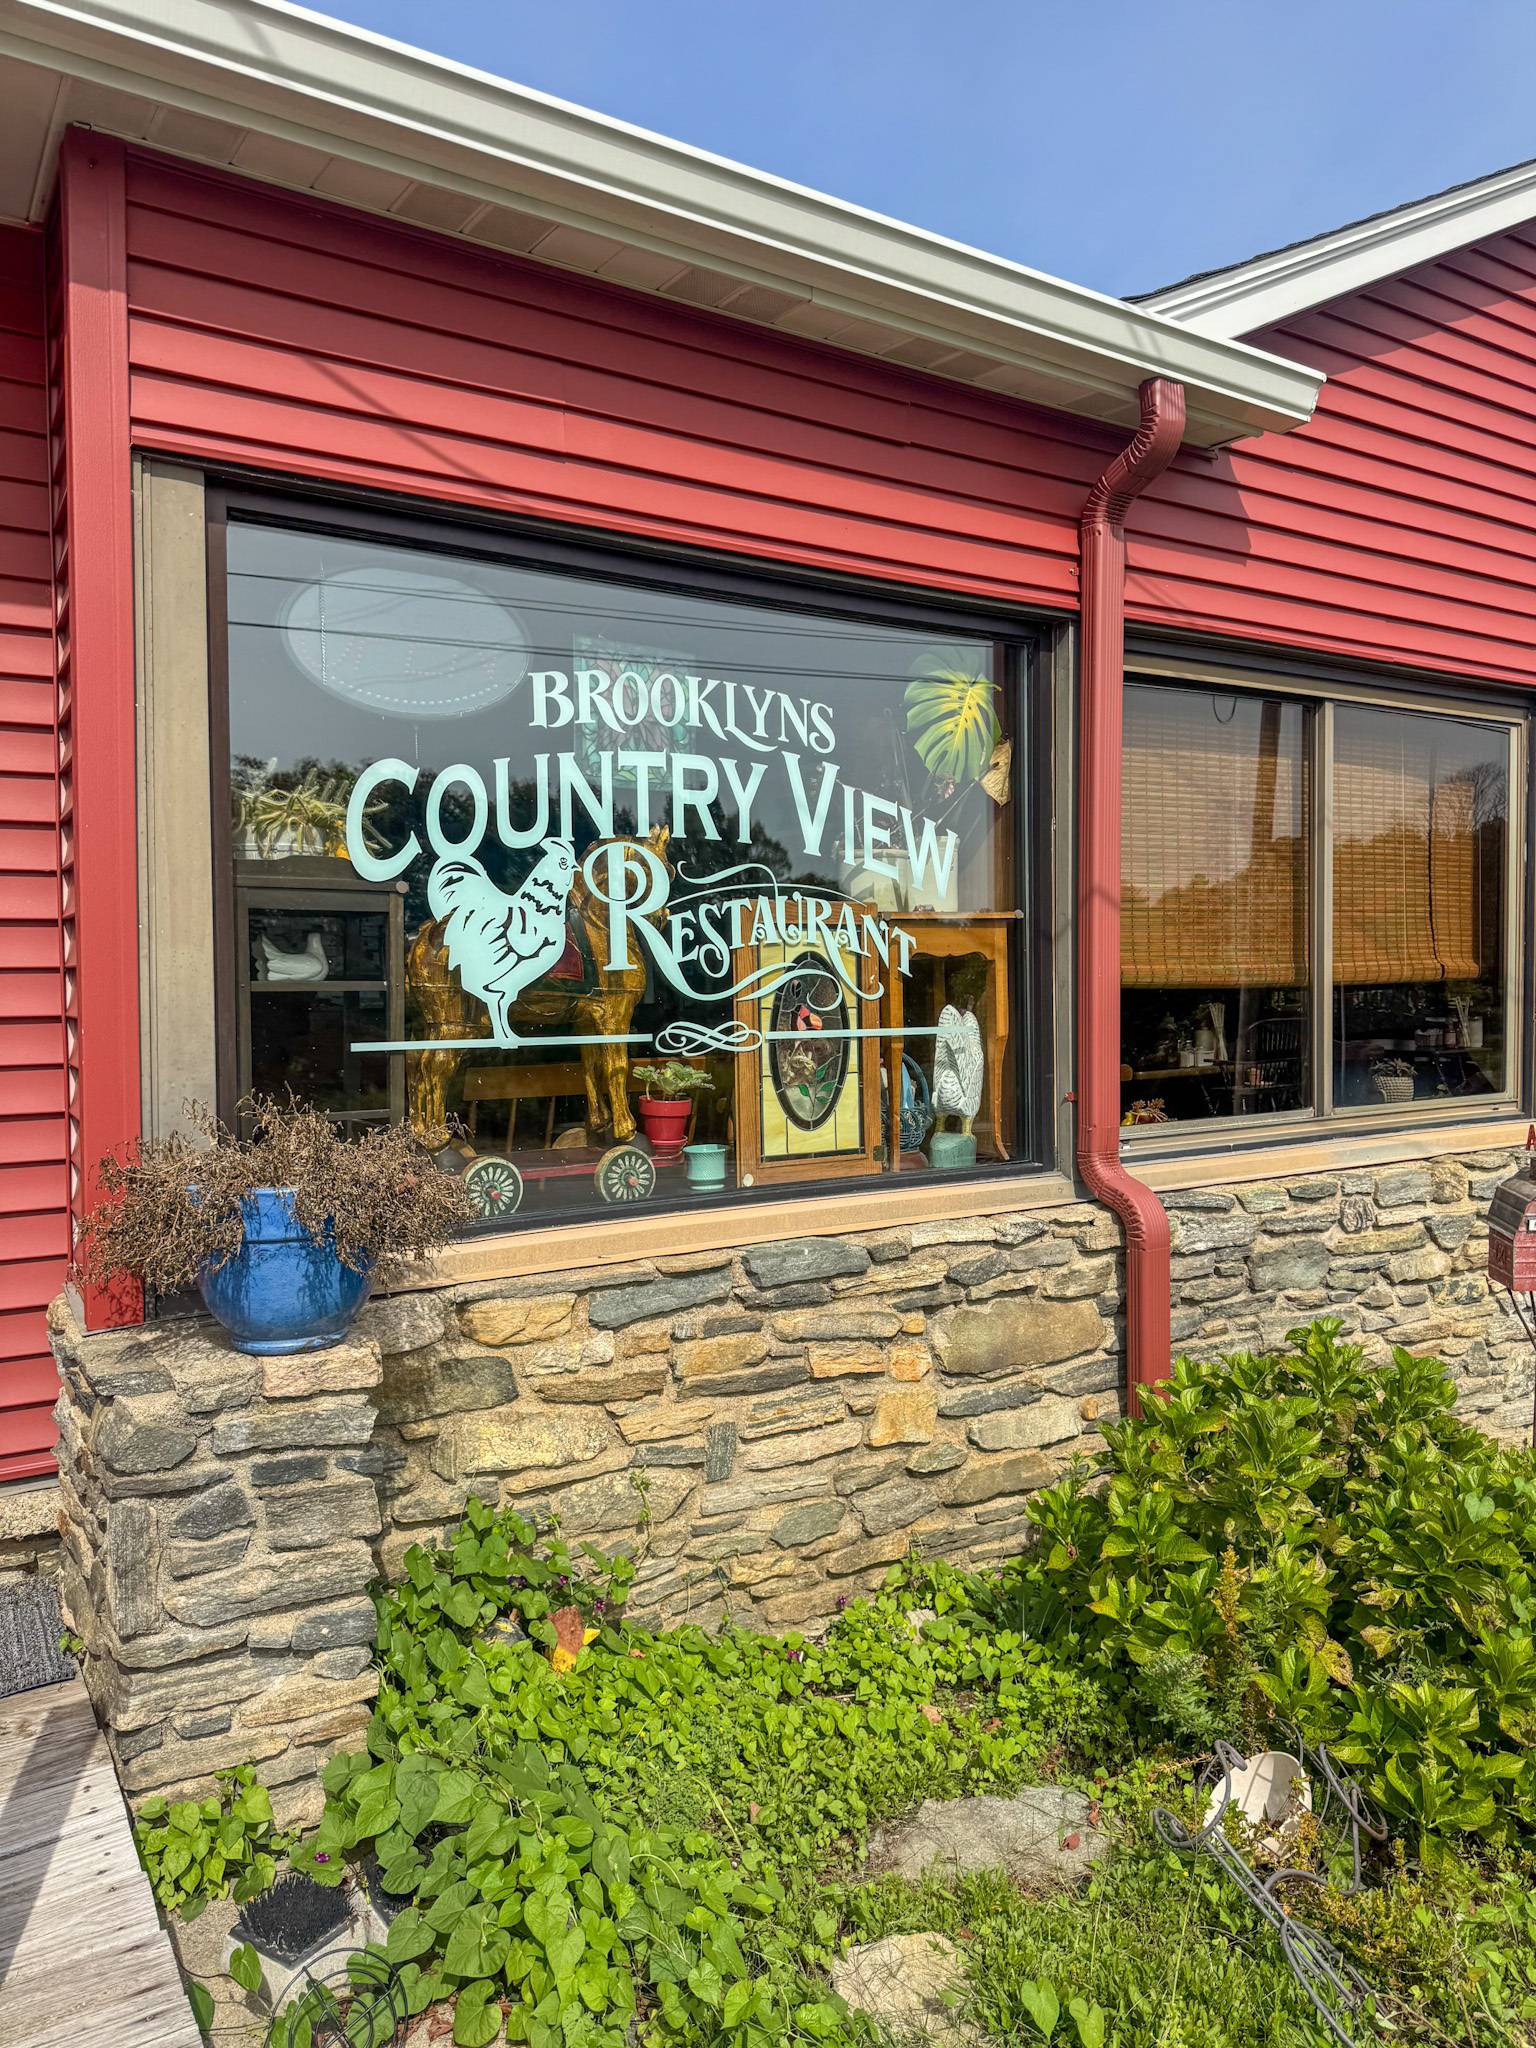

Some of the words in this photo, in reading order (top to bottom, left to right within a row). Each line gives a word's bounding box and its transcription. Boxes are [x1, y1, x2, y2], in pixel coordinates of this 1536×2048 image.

[528, 671, 836, 754] BROOKLYNS
[346, 748, 768, 882] COUNTRY
[781, 752, 960, 899] VIEW
[583, 841, 918, 1001] RESTAURANT
